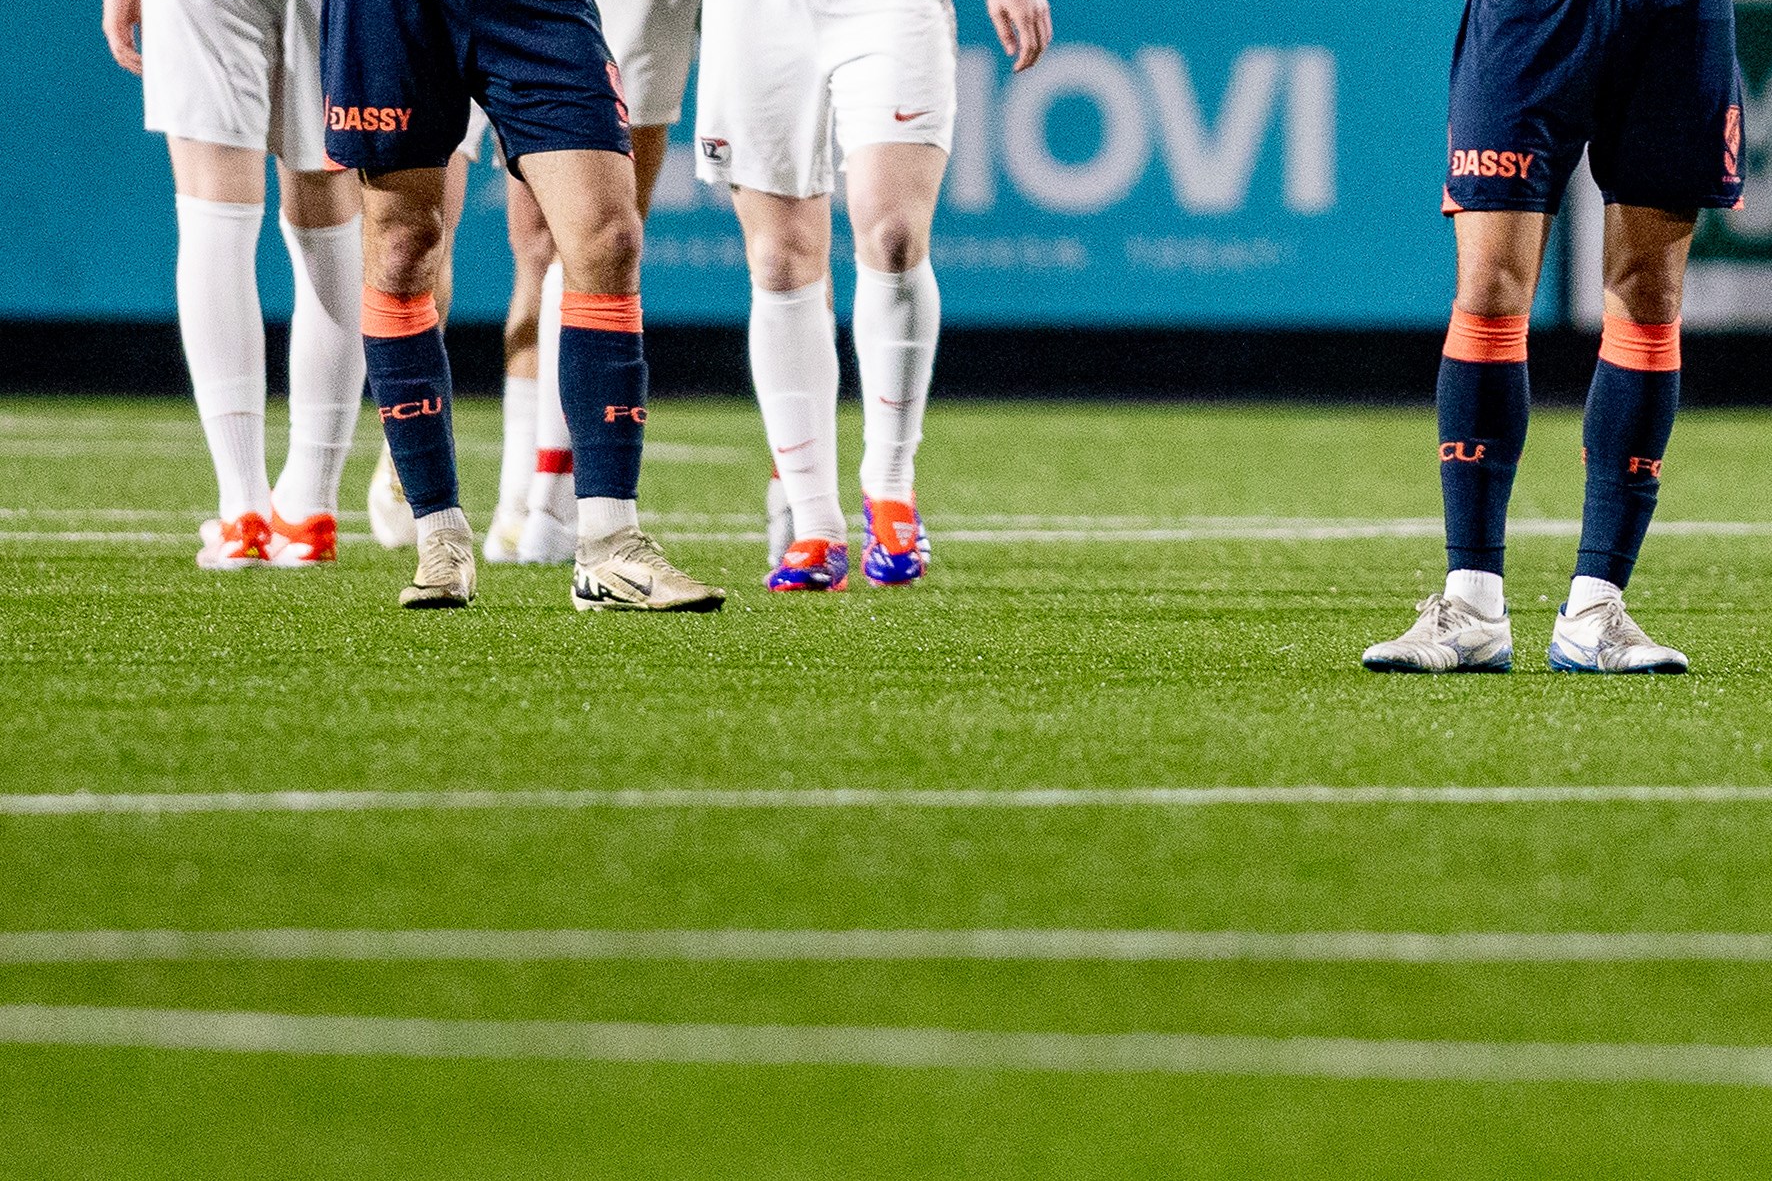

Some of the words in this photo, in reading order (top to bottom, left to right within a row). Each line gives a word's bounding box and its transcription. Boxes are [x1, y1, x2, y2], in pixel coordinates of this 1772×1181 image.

[330, 107, 412, 131] DASSY
[1452, 149, 1534, 179] DASSY
[378, 396, 442, 423] FCU
[604, 405, 648, 424] FC
[1437, 441, 1486, 462] CU
